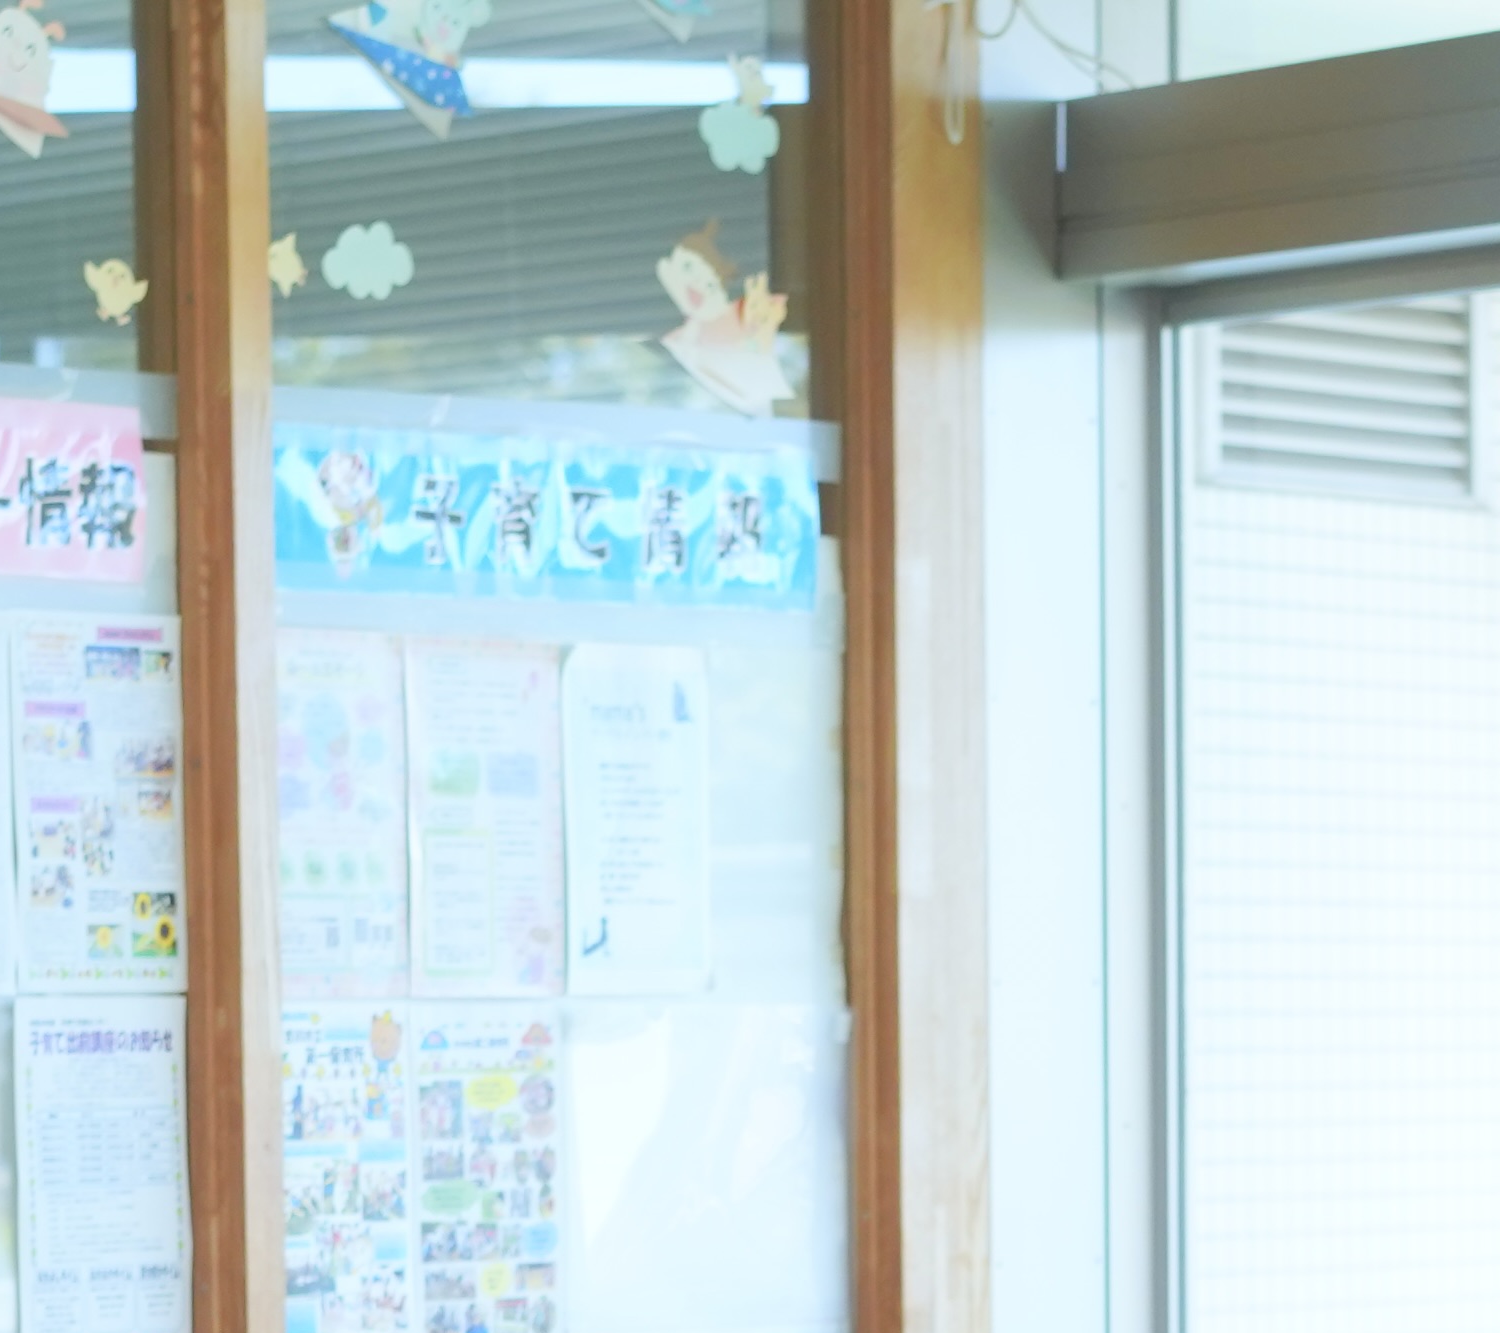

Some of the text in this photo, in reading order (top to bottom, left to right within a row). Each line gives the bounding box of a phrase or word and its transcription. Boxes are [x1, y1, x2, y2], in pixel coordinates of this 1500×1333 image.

[414, 475, 765, 573] 子育て情報
